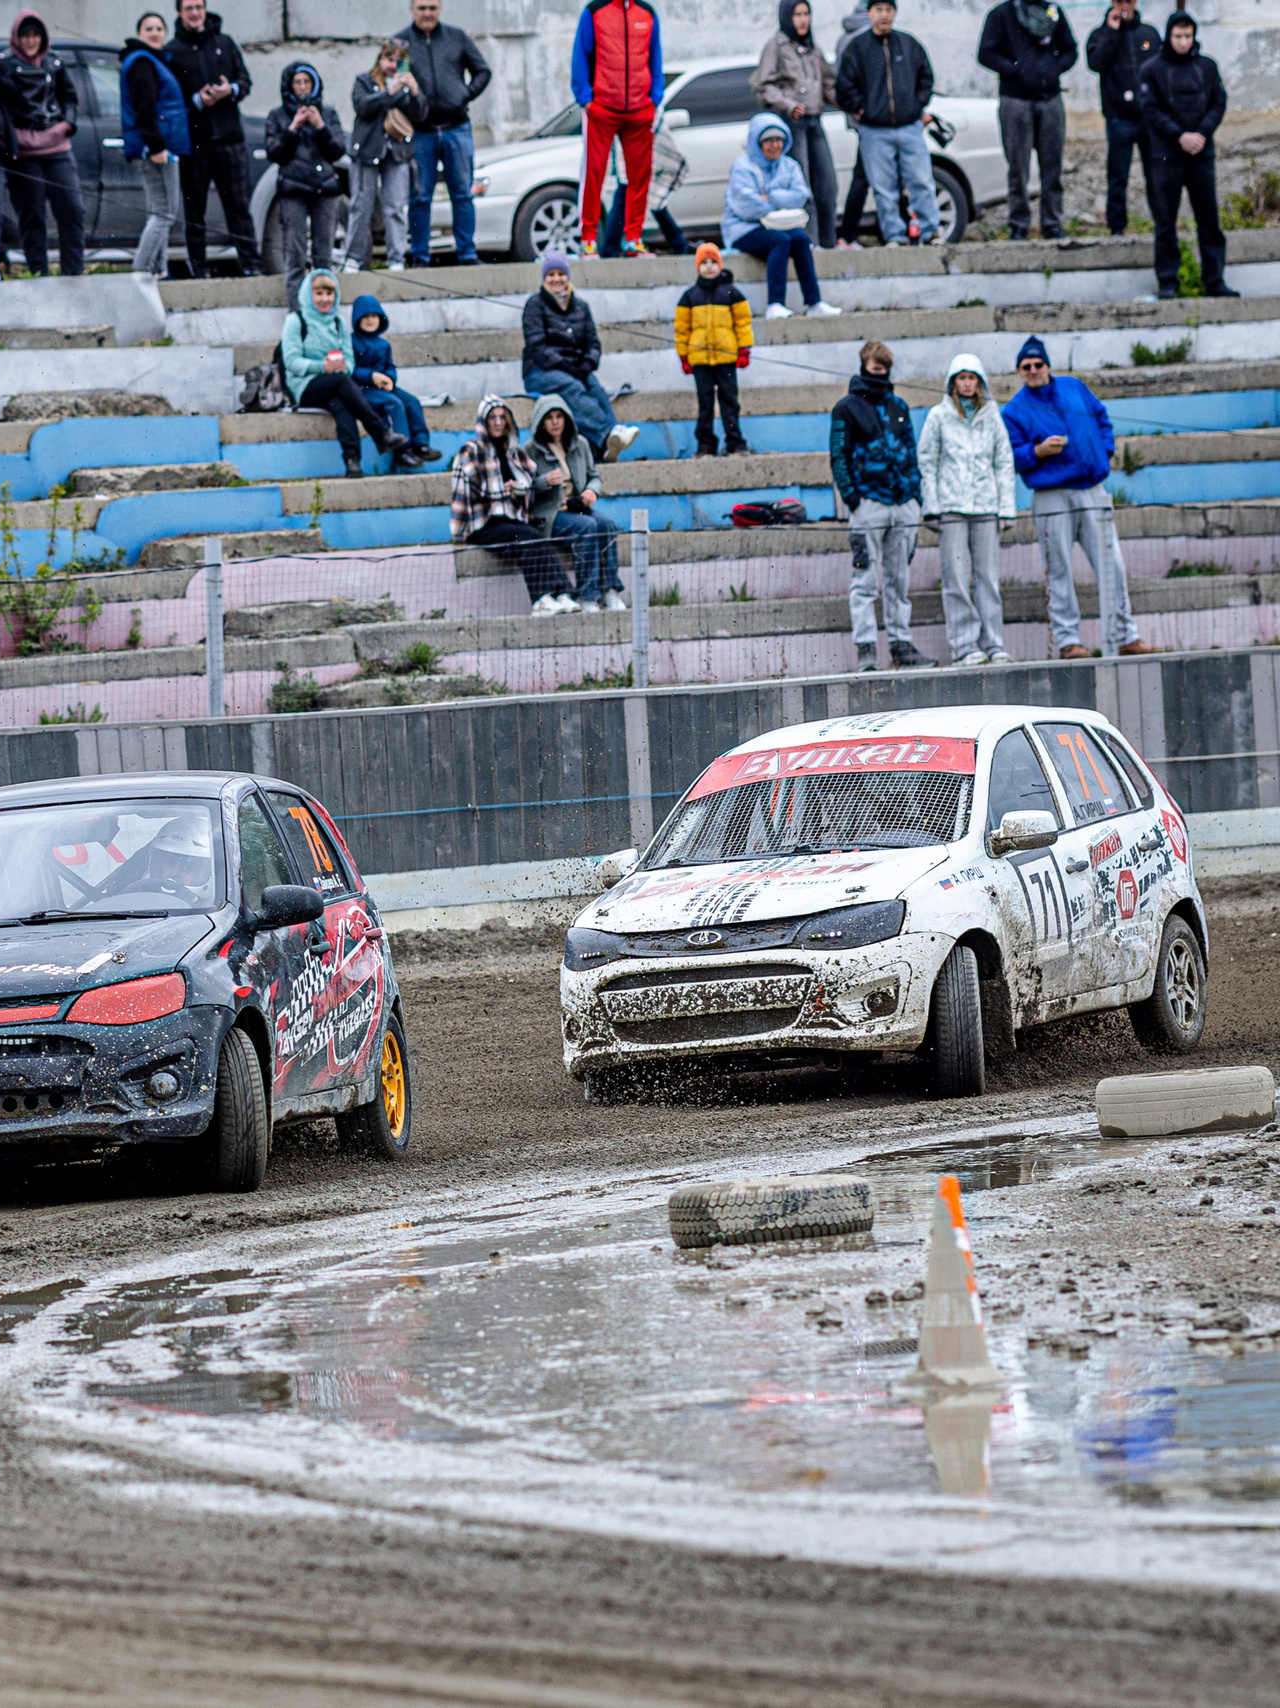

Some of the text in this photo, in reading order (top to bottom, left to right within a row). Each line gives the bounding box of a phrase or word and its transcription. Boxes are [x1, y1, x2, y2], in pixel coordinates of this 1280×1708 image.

[732, 743, 942, 781] Вулкан
[1056, 732, 1109, 799] 71
[287, 806, 334, 872] 78
[1028, 870, 1061, 943] 71
